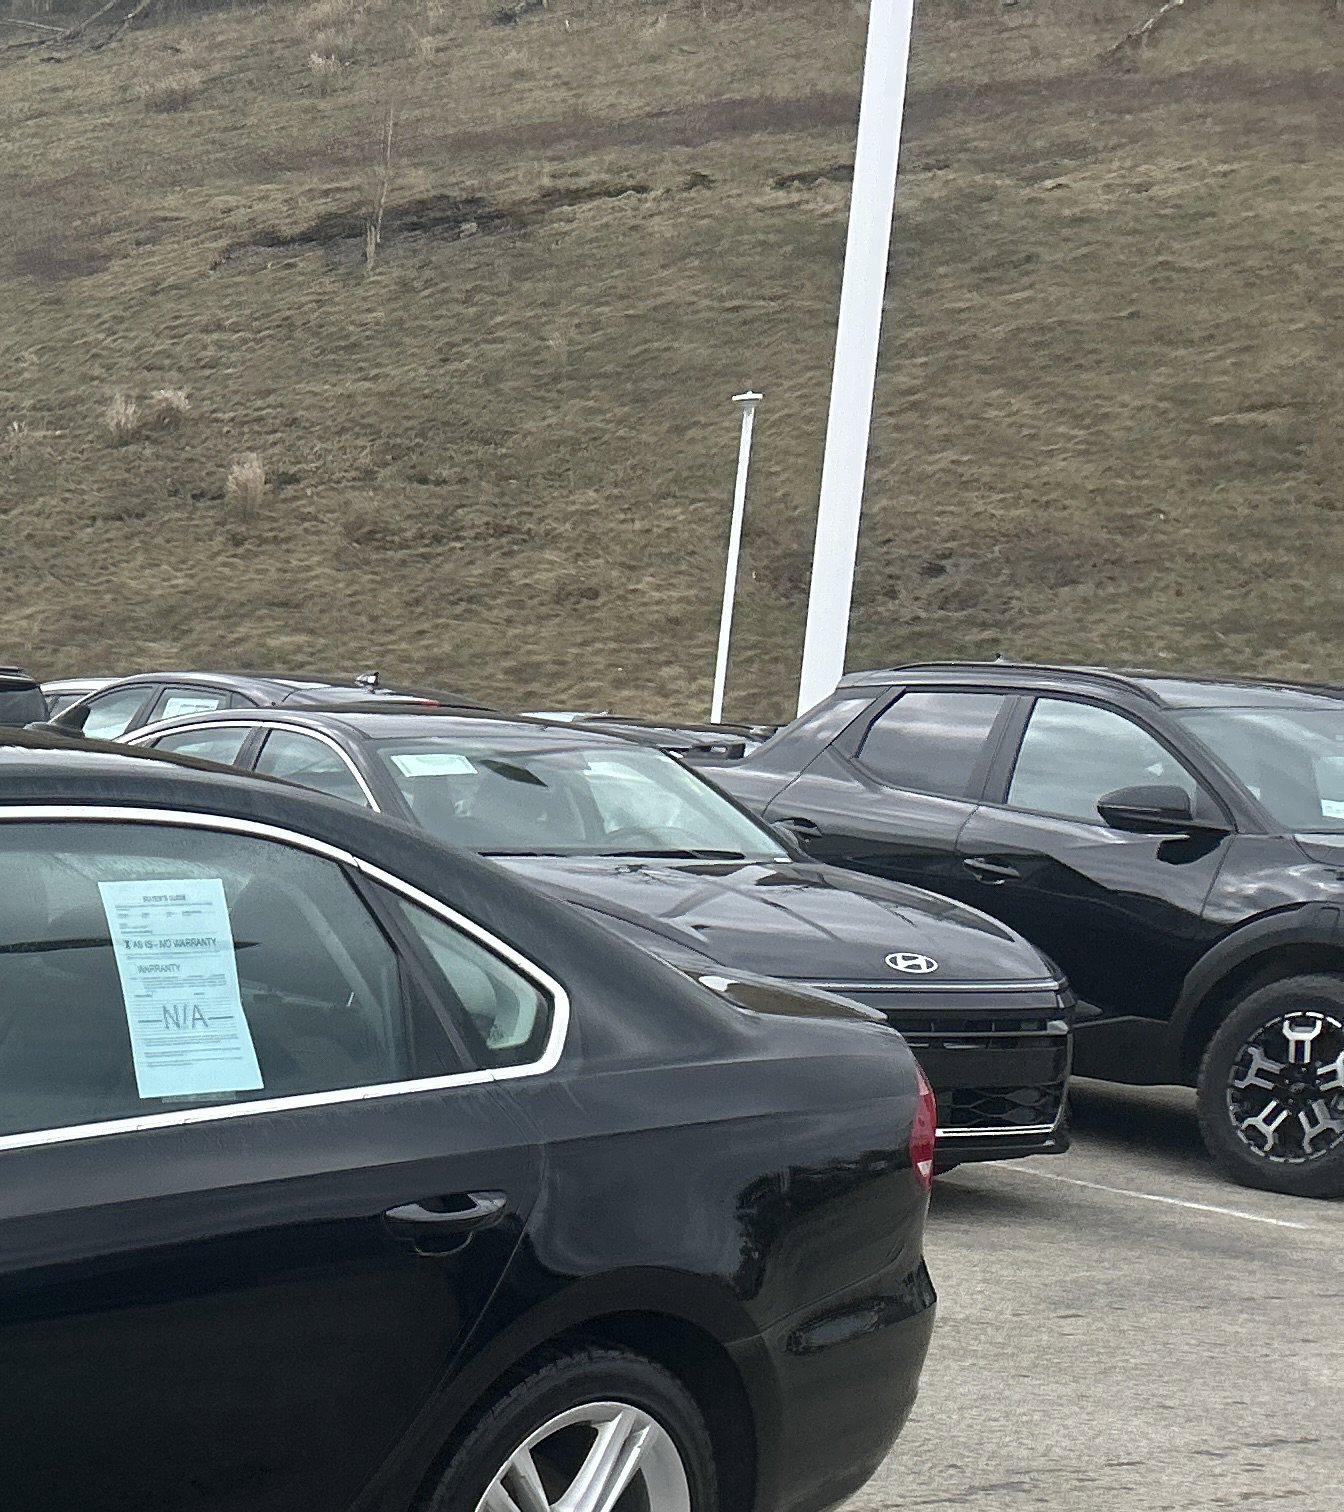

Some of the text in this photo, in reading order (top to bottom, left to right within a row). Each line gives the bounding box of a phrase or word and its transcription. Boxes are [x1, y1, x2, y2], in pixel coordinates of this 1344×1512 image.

[173, 938, 216, 948] WARRANTY
[137, 964, 180, 973] WARRANTY
[162, 1004, 209, 1030] N/A
